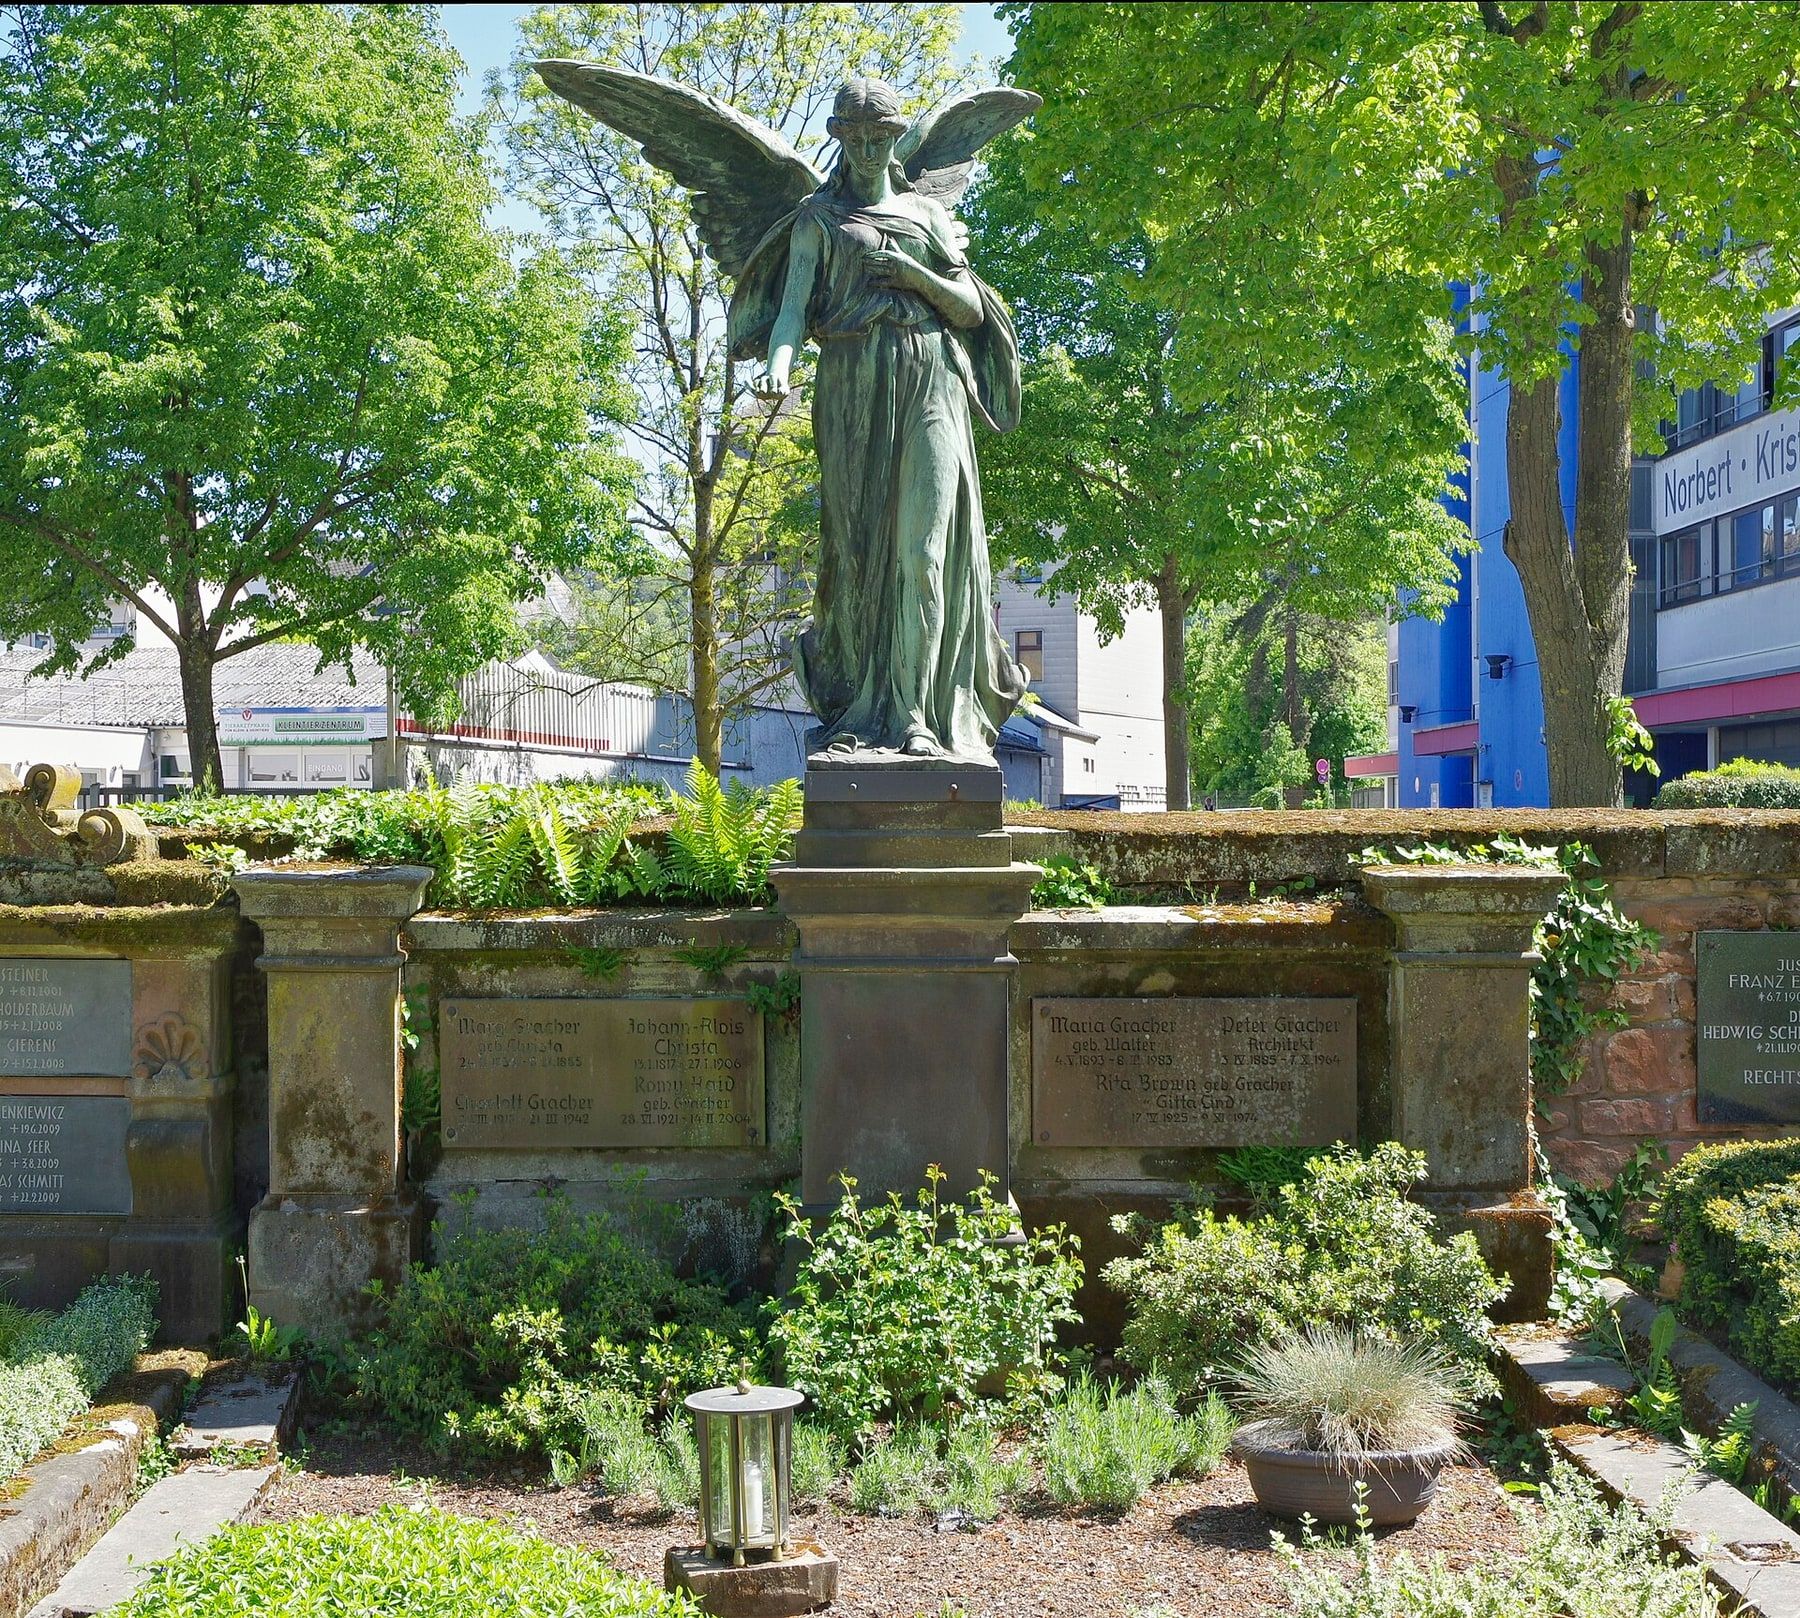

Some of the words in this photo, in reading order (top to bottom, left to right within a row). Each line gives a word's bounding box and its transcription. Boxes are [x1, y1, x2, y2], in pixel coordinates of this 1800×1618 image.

[1665, 450, 1732, 517] Norbert
[1756, 423, 1800, 484] Kris
[279, 720, 361, 729] KLEINTIERZENTRUM
[308, 764, 343, 772] EINGANG
[1729, 974, 1785, 989] FRANZ
[1789, 1010, 1800, 1023] D
[1050, 1016, 1106, 1034] Maria
[1110, 1016, 1178, 1035] Gracher
[1221, 1015, 1267, 1036] Peter
[1274, 1016, 1341, 1034] Gracher
[1703, 1025, 1763, 1040] HEDWIG
[1768, 1025, 1800, 1040] SCH
[7, 1038, 57, 1053] GIERENS
[654, 1038, 719, 1056] Christa
[1072, 1037, 1101, 1054] geb.
[1103, 1037, 1157, 1052] Walter
[1248, 1036, 1316, 1053] Architekt
[634, 1075, 683, 1096] Romy
[1096, 1074, 1131, 1091] Rita
[1139, 1074, 1197, 1092] Brown
[1234, 1075, 1296, 1093] Gracher
[527, 1093, 596, 1111] Gracher
[27, 1140, 52, 1154] SEER
[18, 1174, 65, 1188] SCHMITT
